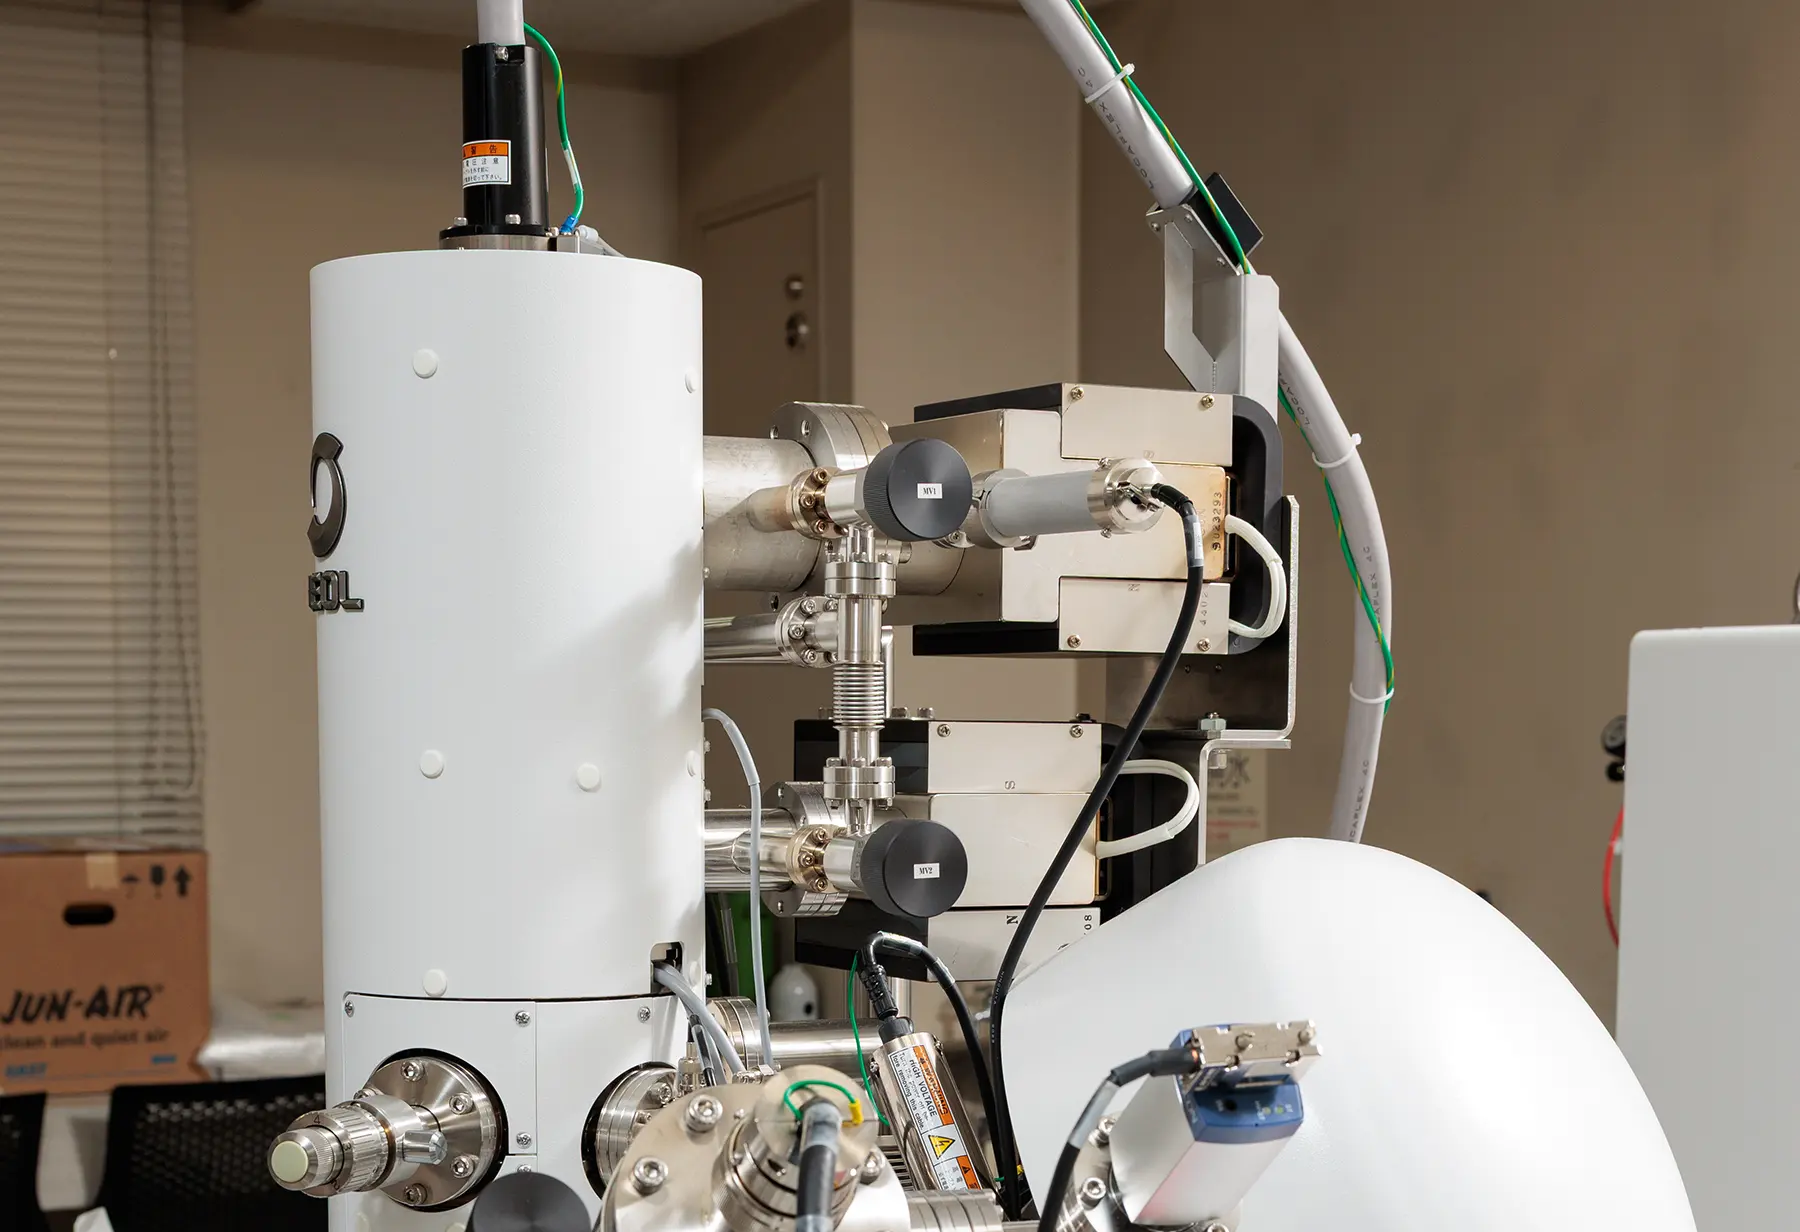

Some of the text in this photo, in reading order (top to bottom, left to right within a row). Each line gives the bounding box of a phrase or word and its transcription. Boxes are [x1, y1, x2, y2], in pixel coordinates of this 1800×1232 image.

[923, 487, 936, 495] MV1
[919, 866, 933, 875] MV2
[892, 1054, 901, 1068] fore
[898, 1069, 912, 1098] removing
[909, 1098, 917, 1112] this
[909, 1060, 938, 1118] HIGH VOLTAGE
[924, 1066, 949, 1116] WARNING
